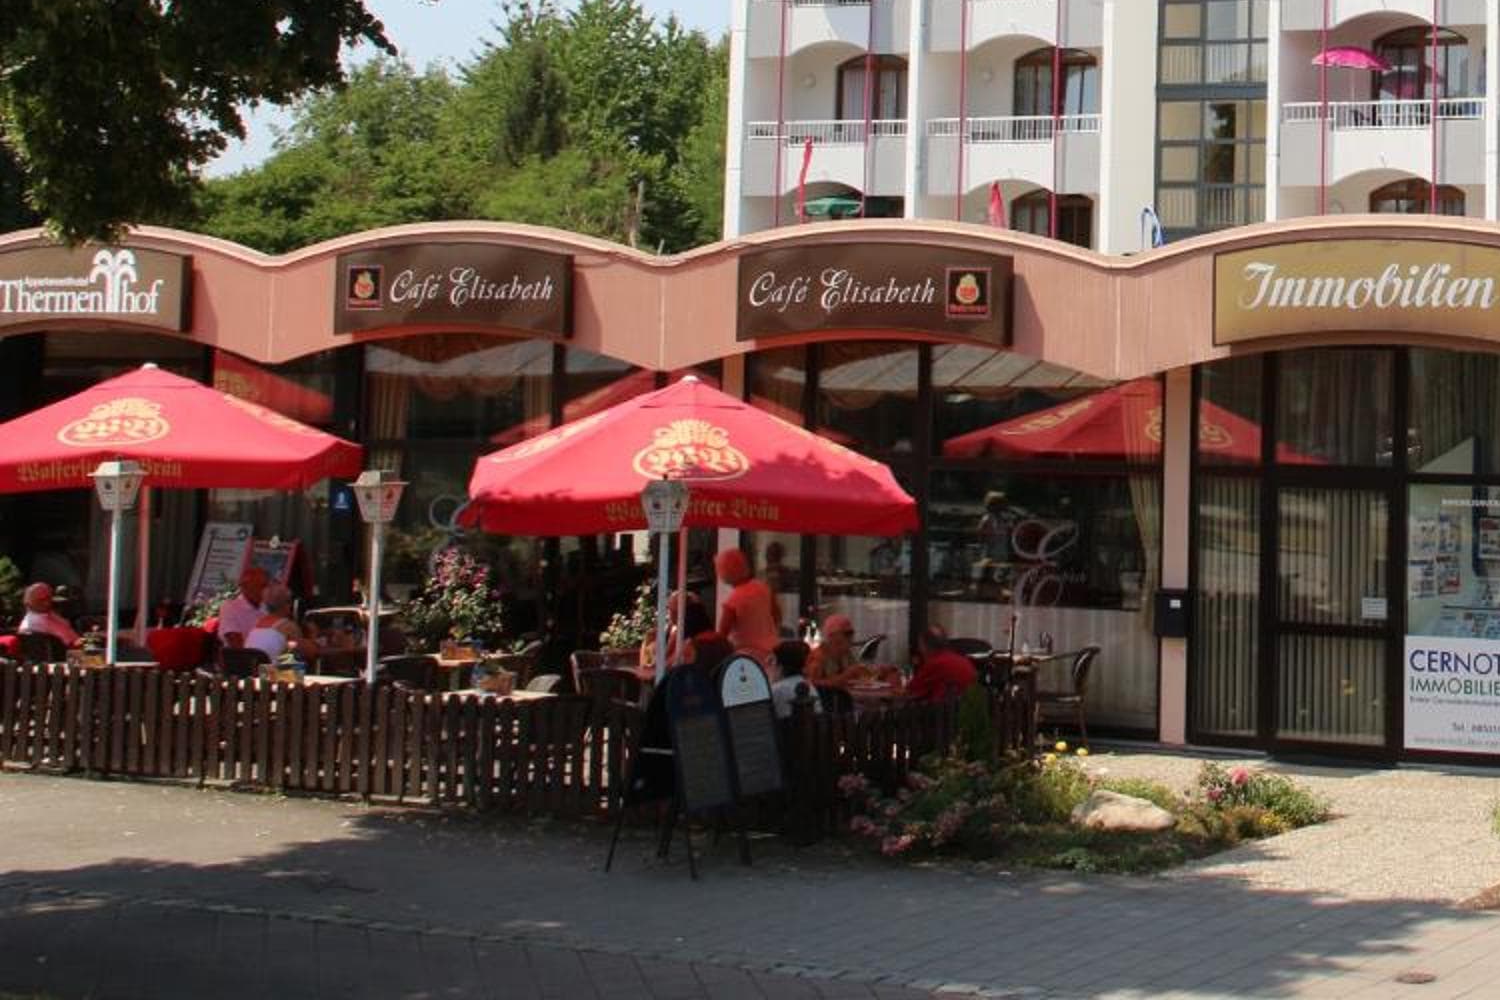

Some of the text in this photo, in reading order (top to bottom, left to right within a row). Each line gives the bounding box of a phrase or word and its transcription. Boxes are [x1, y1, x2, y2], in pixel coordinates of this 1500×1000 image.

[389, 267, 553, 308] Café Elisabeth
[749, 268, 935, 313] Café Elisabeth
[1239, 261, 1498, 310] Immobilien
